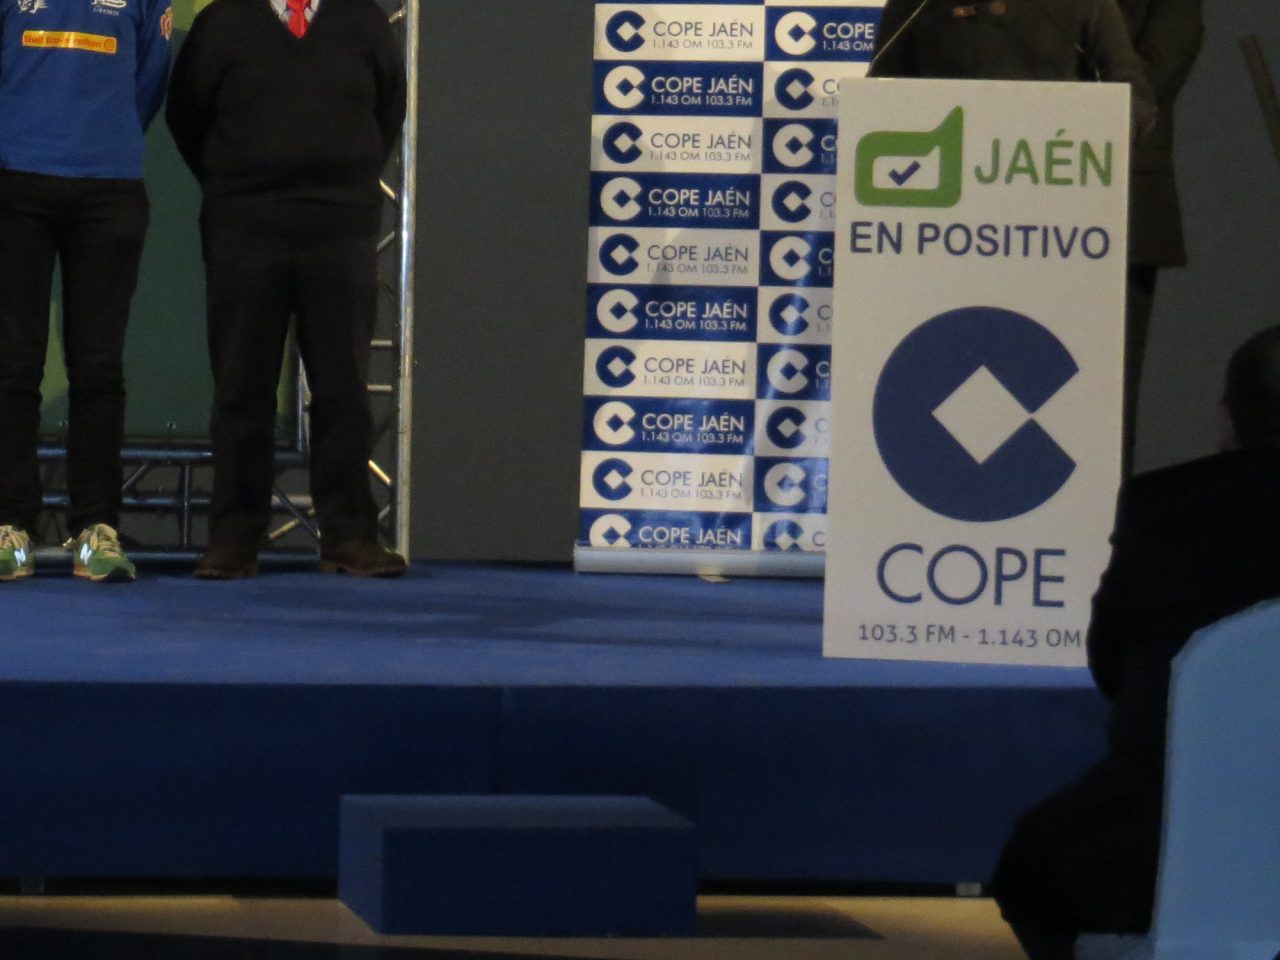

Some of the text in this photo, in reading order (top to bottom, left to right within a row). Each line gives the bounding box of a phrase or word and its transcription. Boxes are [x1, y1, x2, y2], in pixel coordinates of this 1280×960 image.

[653, 19, 753, 37] COPE JAÉN
[823, 23, 874, 39] COPE
[653, 39, 753, 49] 1.143 OM 103.3 FM
[823, 40, 873, 51] 1.143 OM
[651, 75, 752, 93] COPE JAÉN
[652, 94, 752, 105] 1.143 OM 103.3 FM
[650, 131, 751, 149] COPE JAÉN
[650, 150, 750, 161] 1.143 OM 103.3 FM
[974, 128, 1113, 187] JAÉN
[648, 187, 750, 206] COPE JAÉN
[649, 206, 749, 218] 1.143 OM 103.3 FM
[849, 221, 1110, 260] EN POSITIVO
[647, 243, 749, 262] COPE JAÉN
[647, 262, 748, 274] 1.143 OM 103.3 FM
[645, 299, 747, 319] COPE JAÉN
[645, 319, 747, 330] 1.143 OM 103.3 FM
[644, 355, 746, 375] COPE JAÉN
[642, 411, 744, 430] COPE JAÉN
[640, 467, 743, 487] COPE JAÉN
[639, 523, 742, 543] COPE JAÉN
[876, 542, 1066, 608] COPE
[858, 624, 917, 643] 103.3
[926, 624, 956, 644] FM
[978, 628, 1038, 648] 1.143
[1046, 628, 1081, 648] OM
